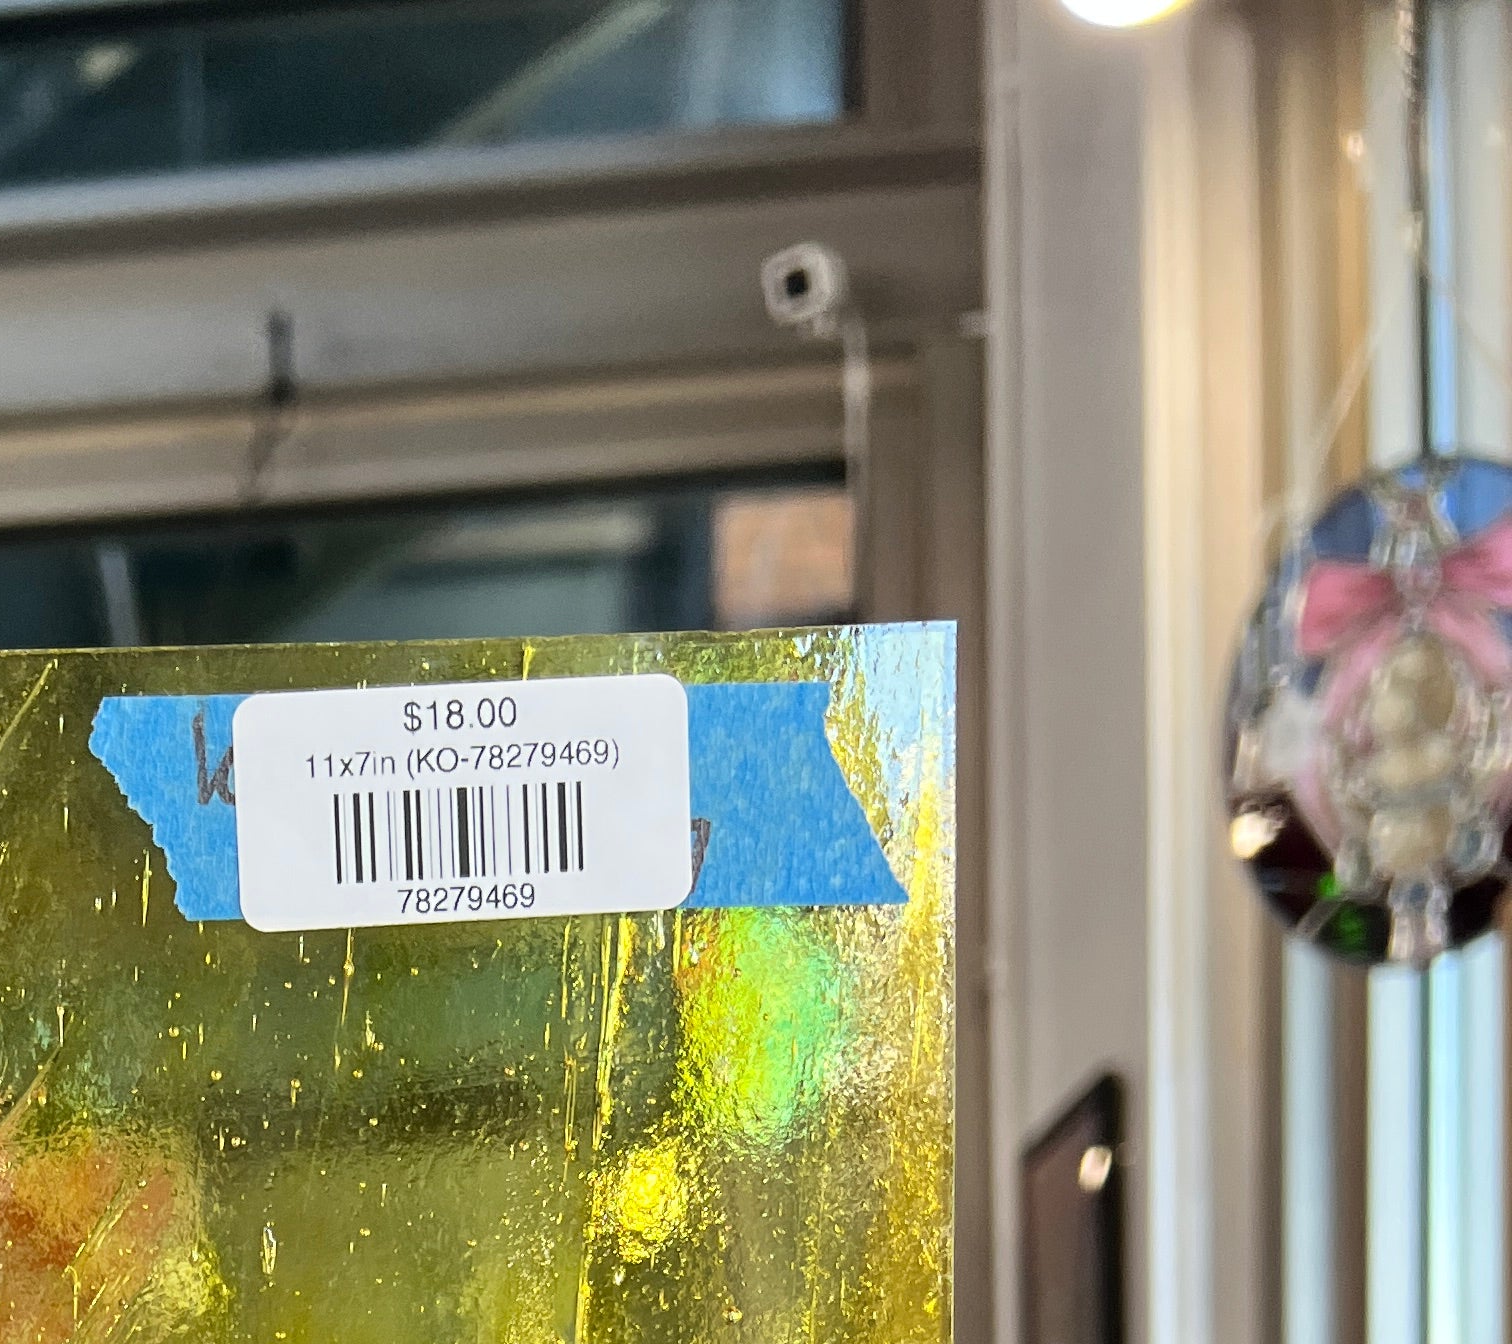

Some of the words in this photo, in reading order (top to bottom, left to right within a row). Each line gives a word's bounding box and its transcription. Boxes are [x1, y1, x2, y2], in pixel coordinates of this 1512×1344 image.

[403, 696, 517, 734] $18.00
[305, 751, 397, 778] 11x7in
[406, 739, 620, 780] (KO-78279469)
[397, 882, 536, 914] 78279469
